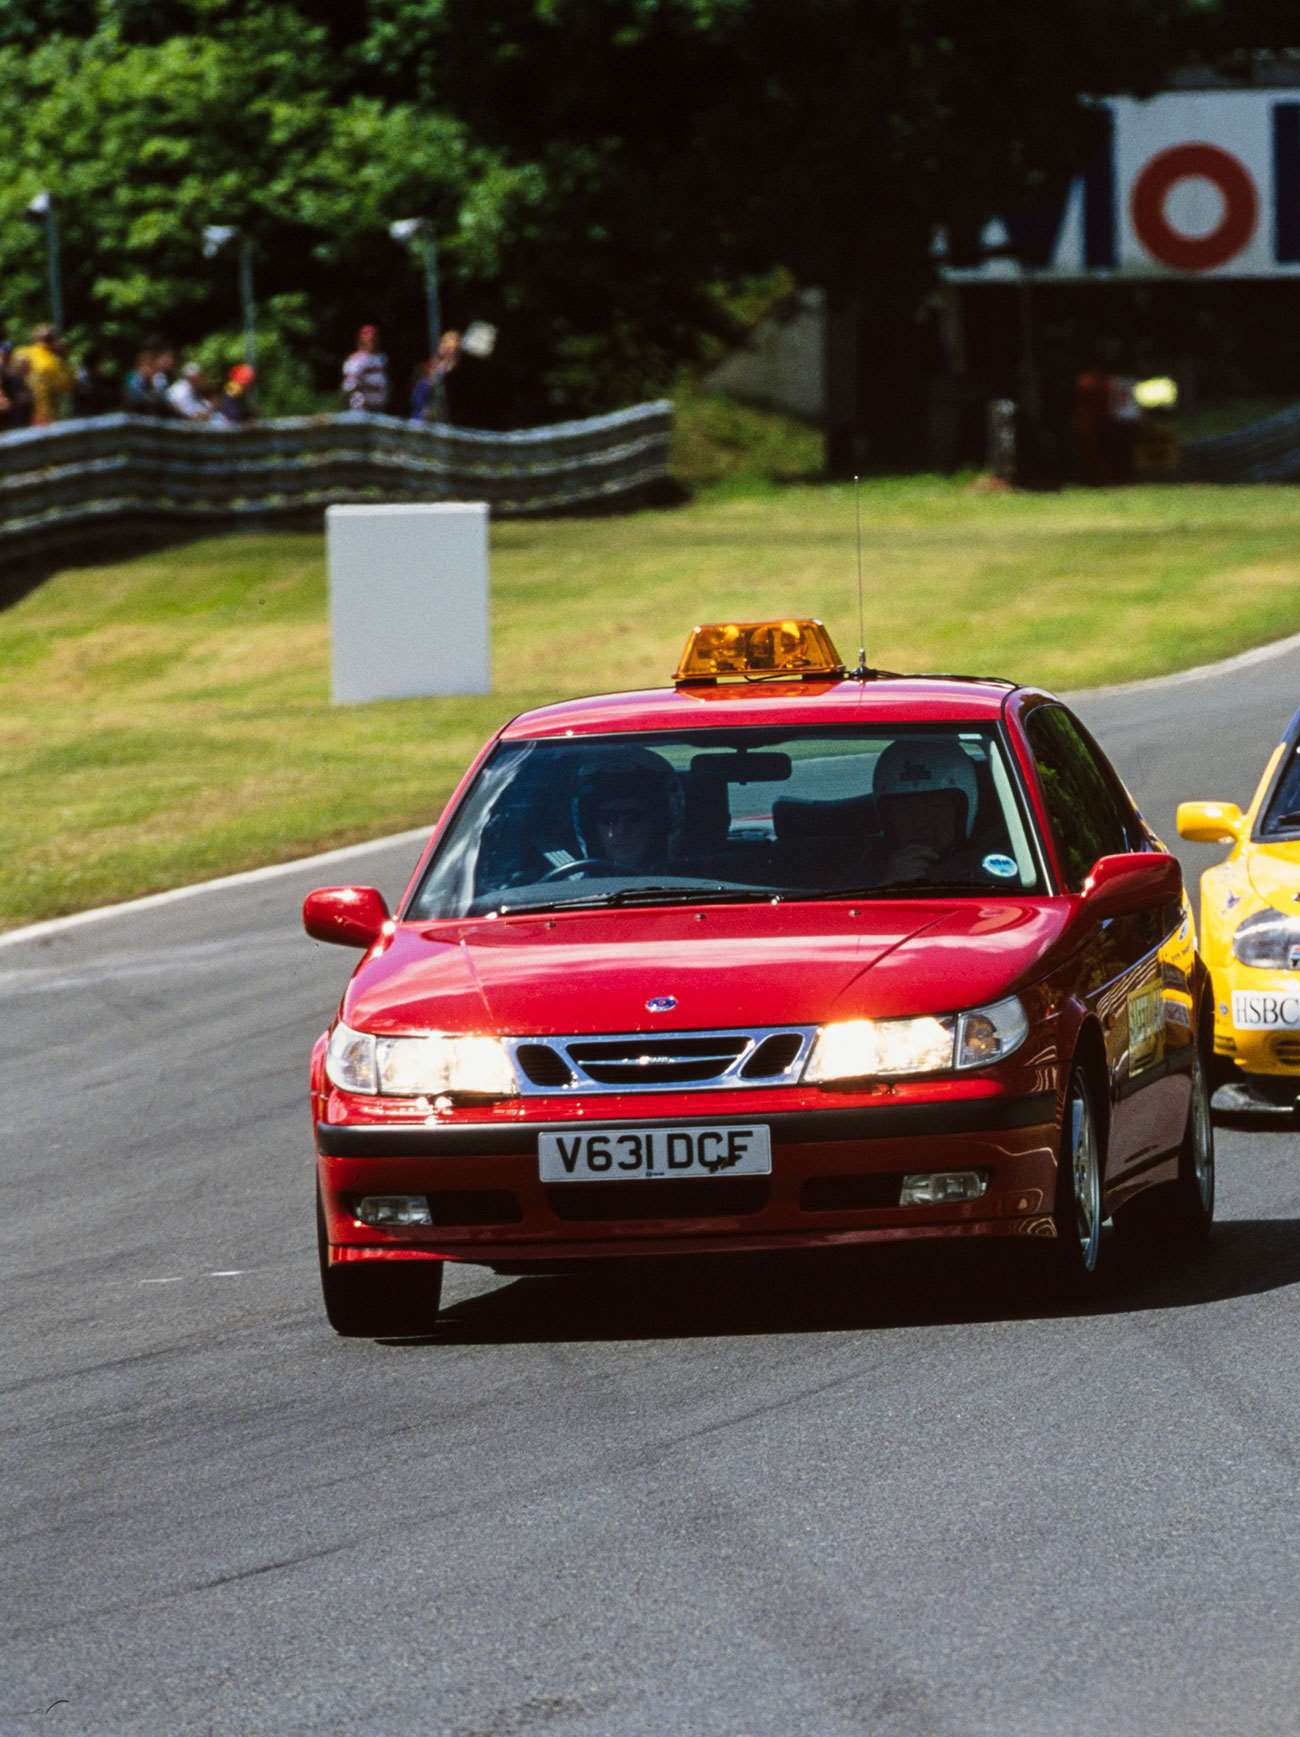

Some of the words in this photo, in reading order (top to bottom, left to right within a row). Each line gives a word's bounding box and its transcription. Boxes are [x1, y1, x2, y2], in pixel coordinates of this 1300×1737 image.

[1234, 997, 1300, 1026] HSBC
[555, 1133, 654, 1174] V631
[666, 1129, 754, 1175] DCF
